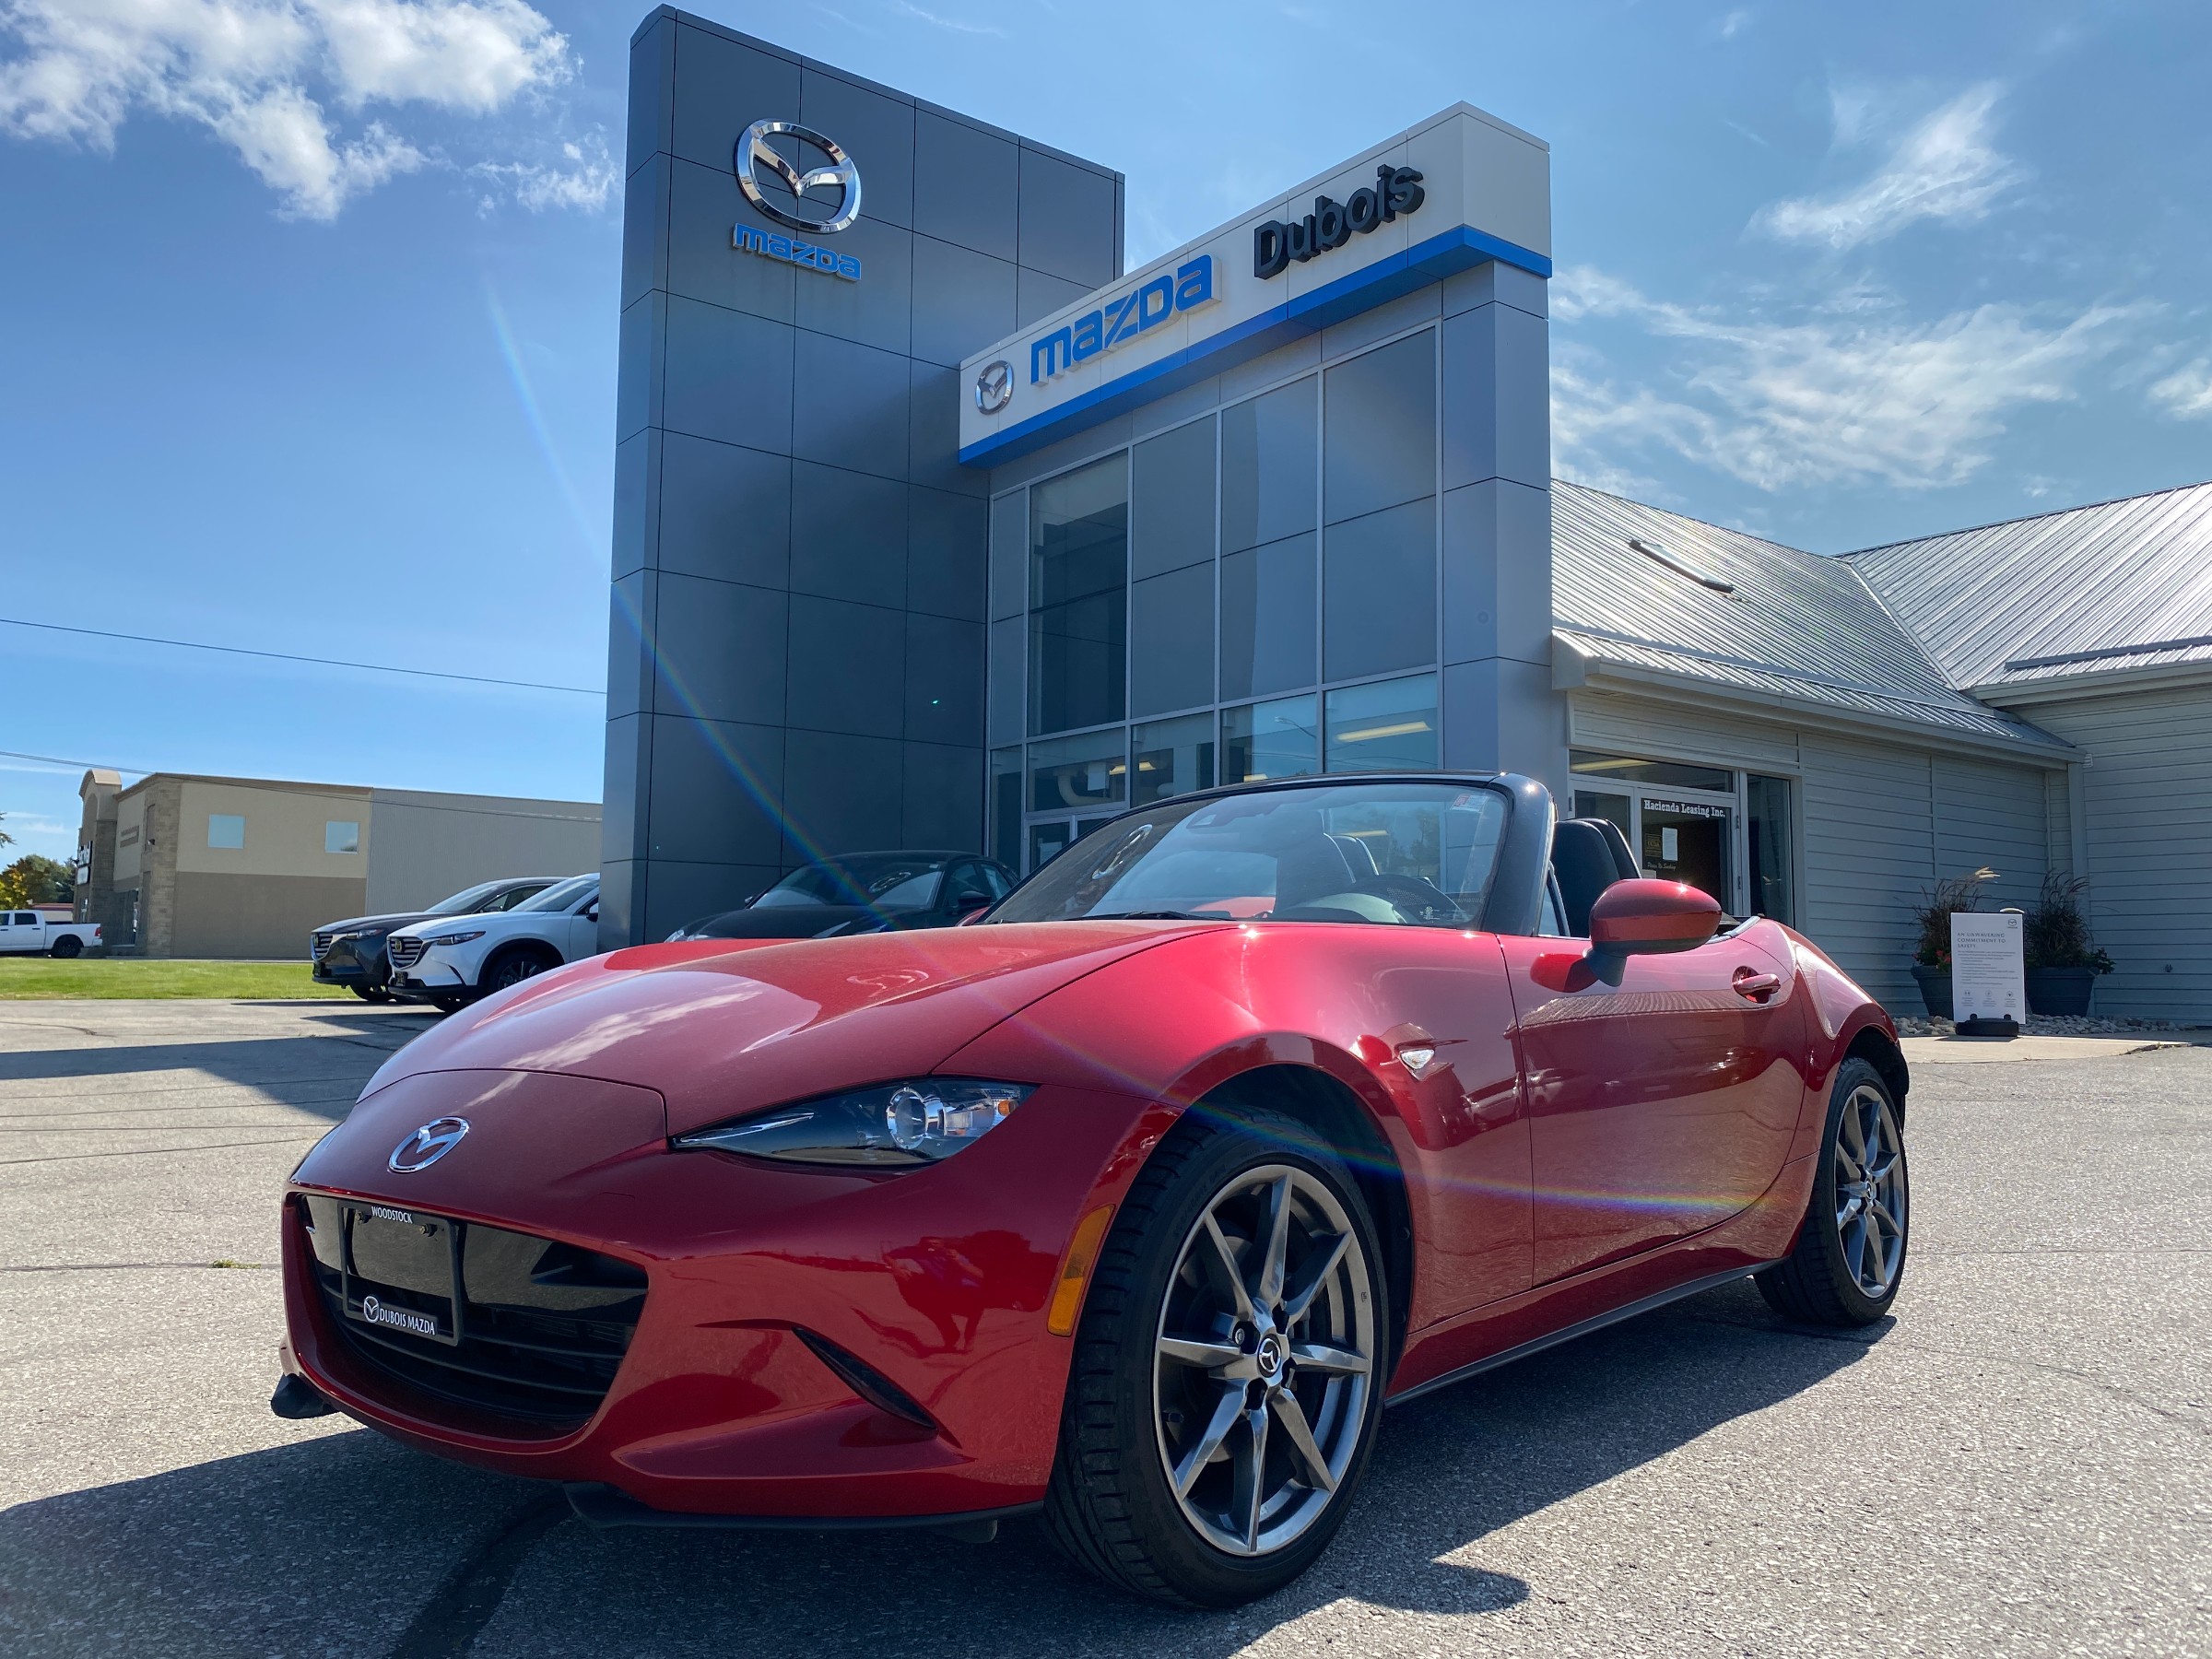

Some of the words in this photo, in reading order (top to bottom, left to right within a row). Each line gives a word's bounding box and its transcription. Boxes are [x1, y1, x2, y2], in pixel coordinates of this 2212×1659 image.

[1253, 163, 1426, 280] Dubois
[1643, 799, 1679, 813] Hacienda
[1681, 803, 1710, 818] Leasing
[1711, 806, 1725, 818] Inc.
[371, 1206, 413, 1224] WOODSTOCK
[379, 1308, 406, 1327] DUBOIS
[406, 1316, 435, 1335] MAZDA
